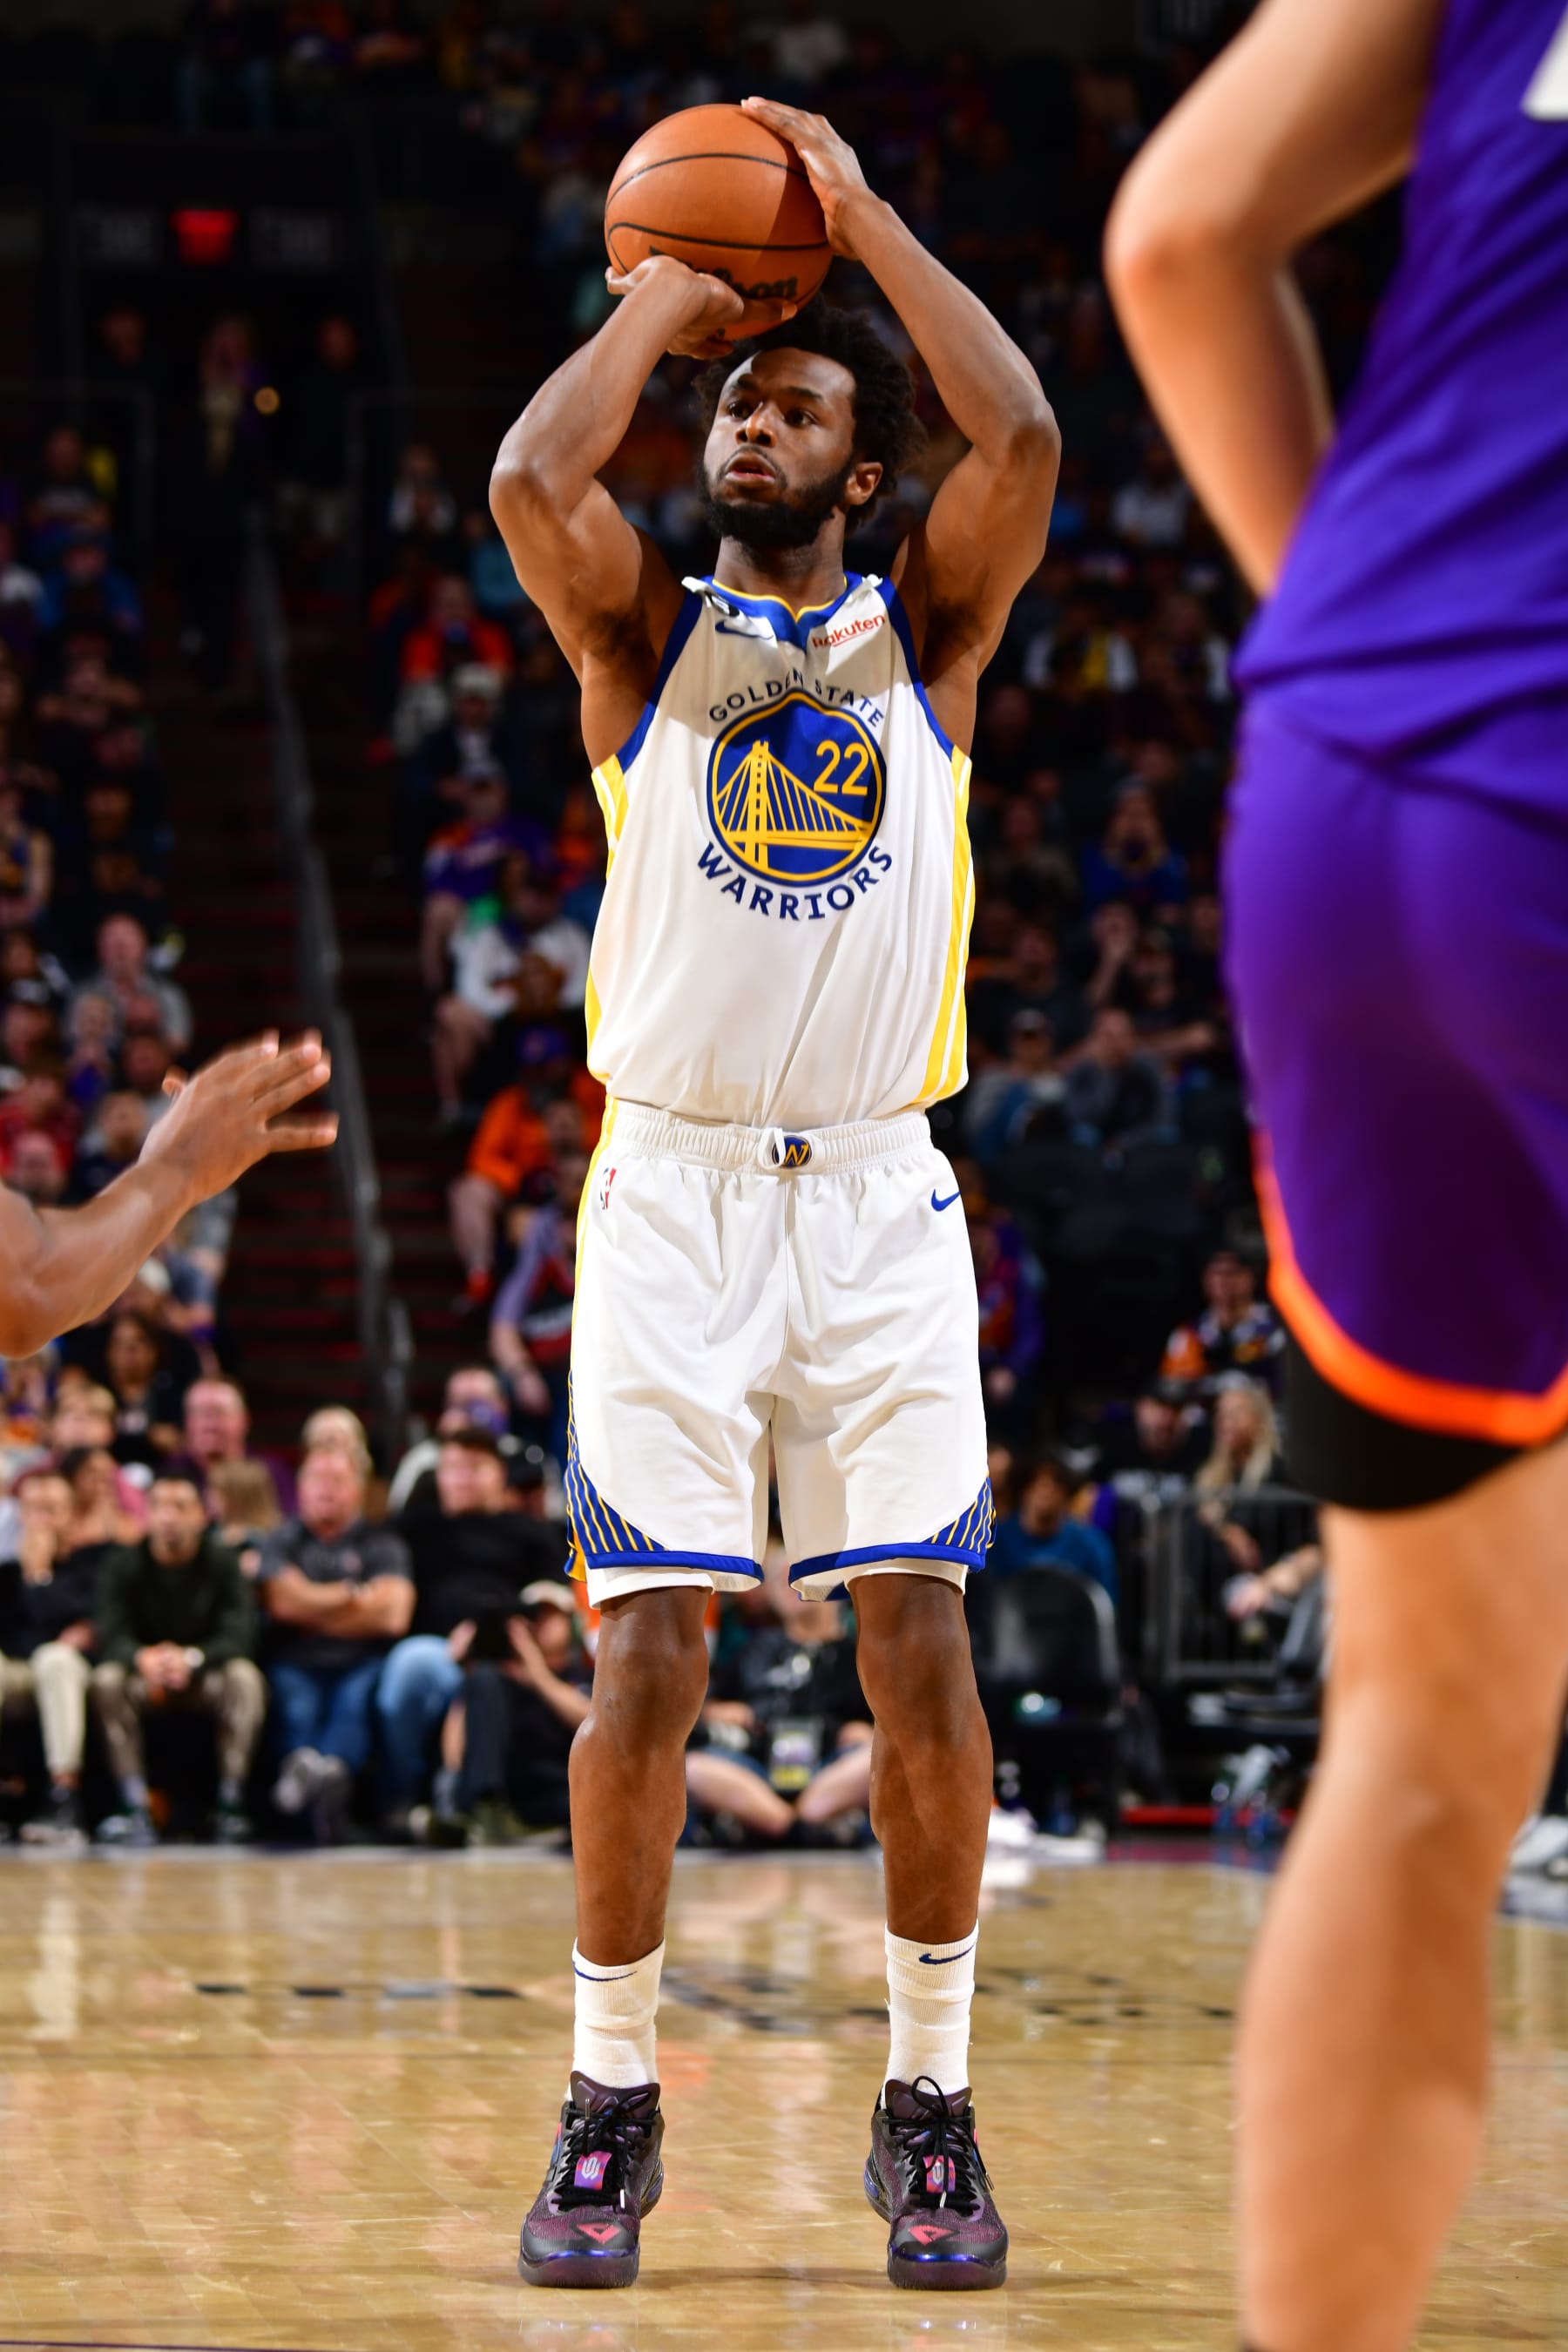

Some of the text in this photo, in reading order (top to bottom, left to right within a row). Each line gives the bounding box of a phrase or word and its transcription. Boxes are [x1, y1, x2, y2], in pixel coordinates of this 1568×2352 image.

[709, 667, 884, 728] GOLDEN STATE
[814, 740, 868, 796] 22
[697, 841, 893, 922] WARRIORS
